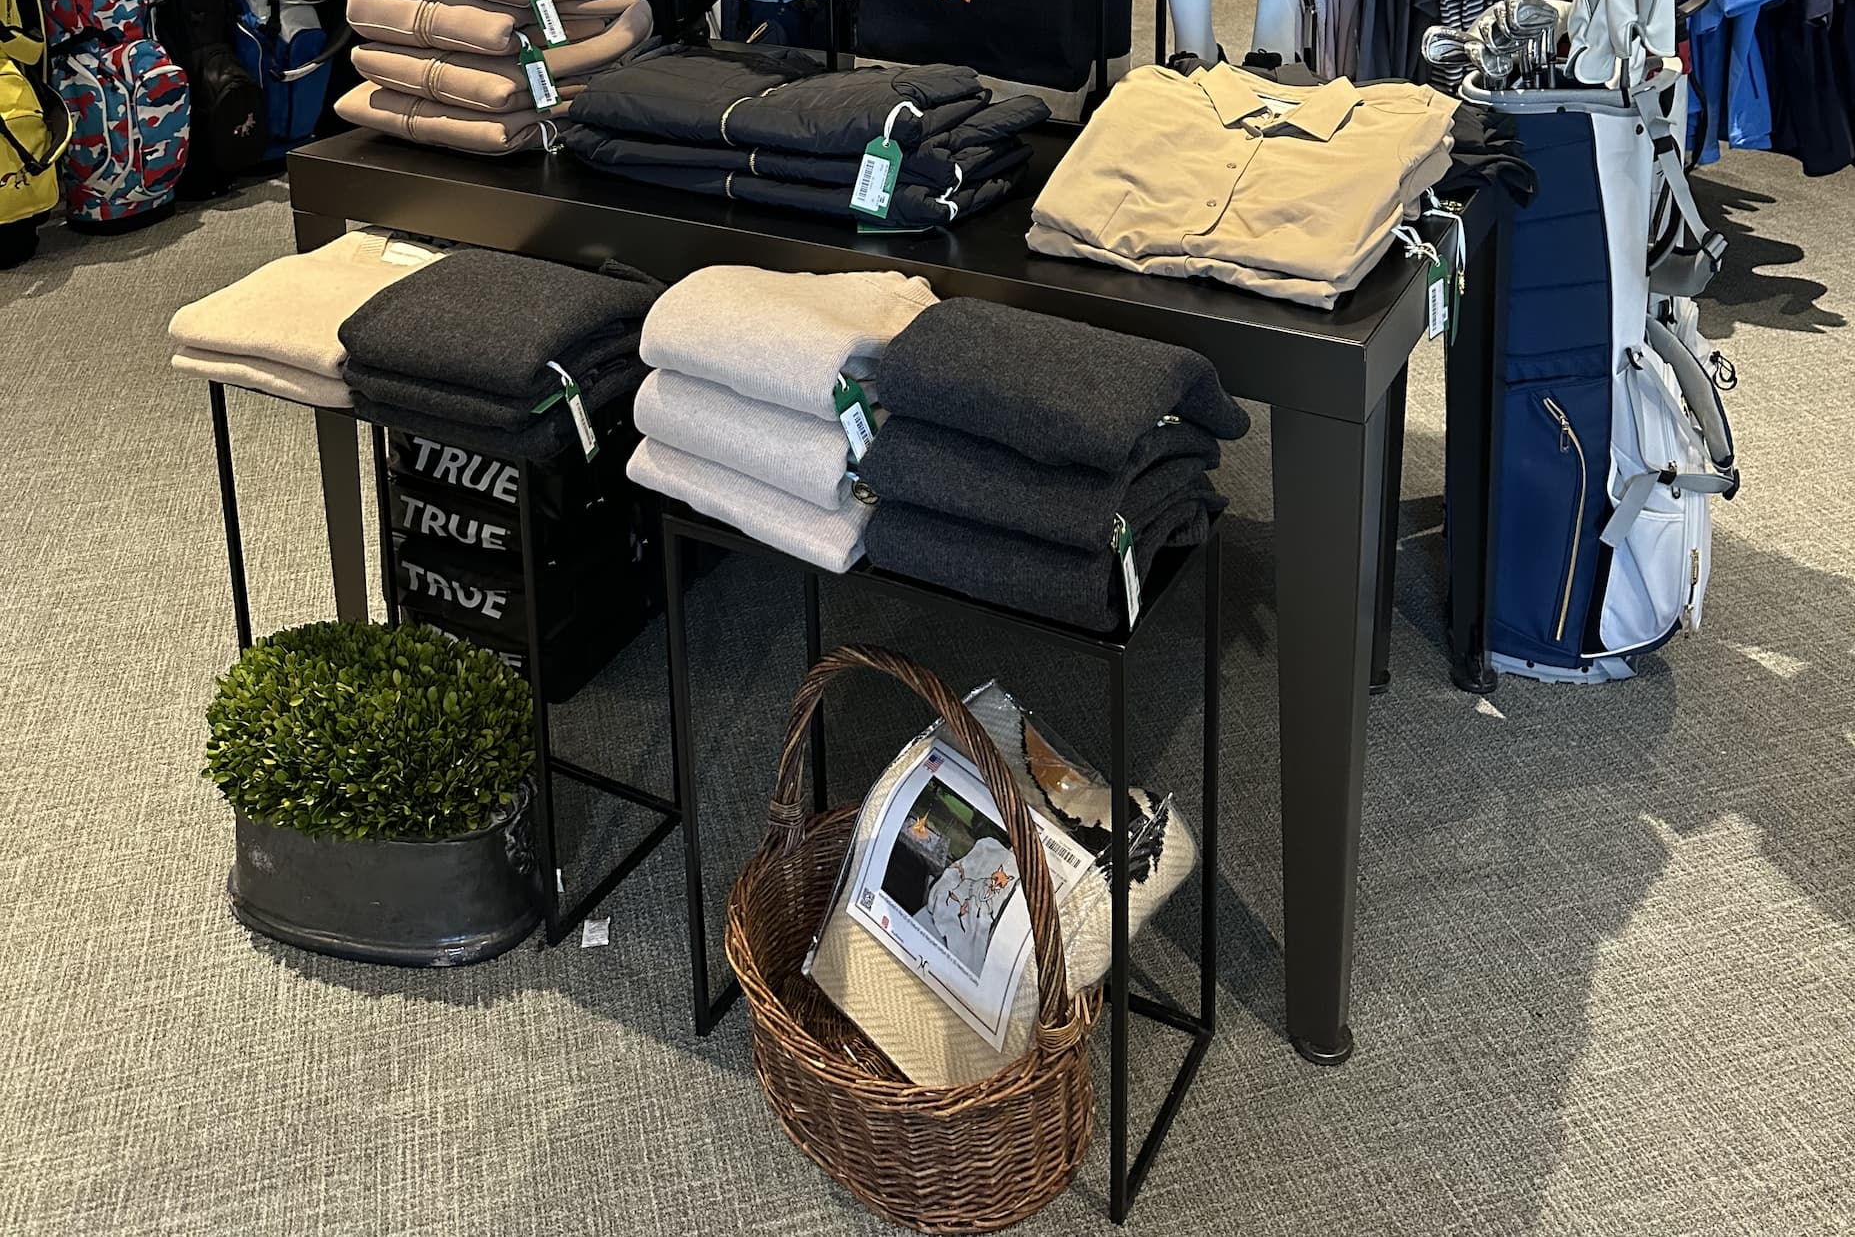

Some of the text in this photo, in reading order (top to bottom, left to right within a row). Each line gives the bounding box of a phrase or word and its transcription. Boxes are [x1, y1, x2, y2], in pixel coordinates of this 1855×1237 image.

[413, 436, 519, 503] TRUE
[400, 495, 507, 551] TRUE
[401, 560, 507, 620] TRUE
